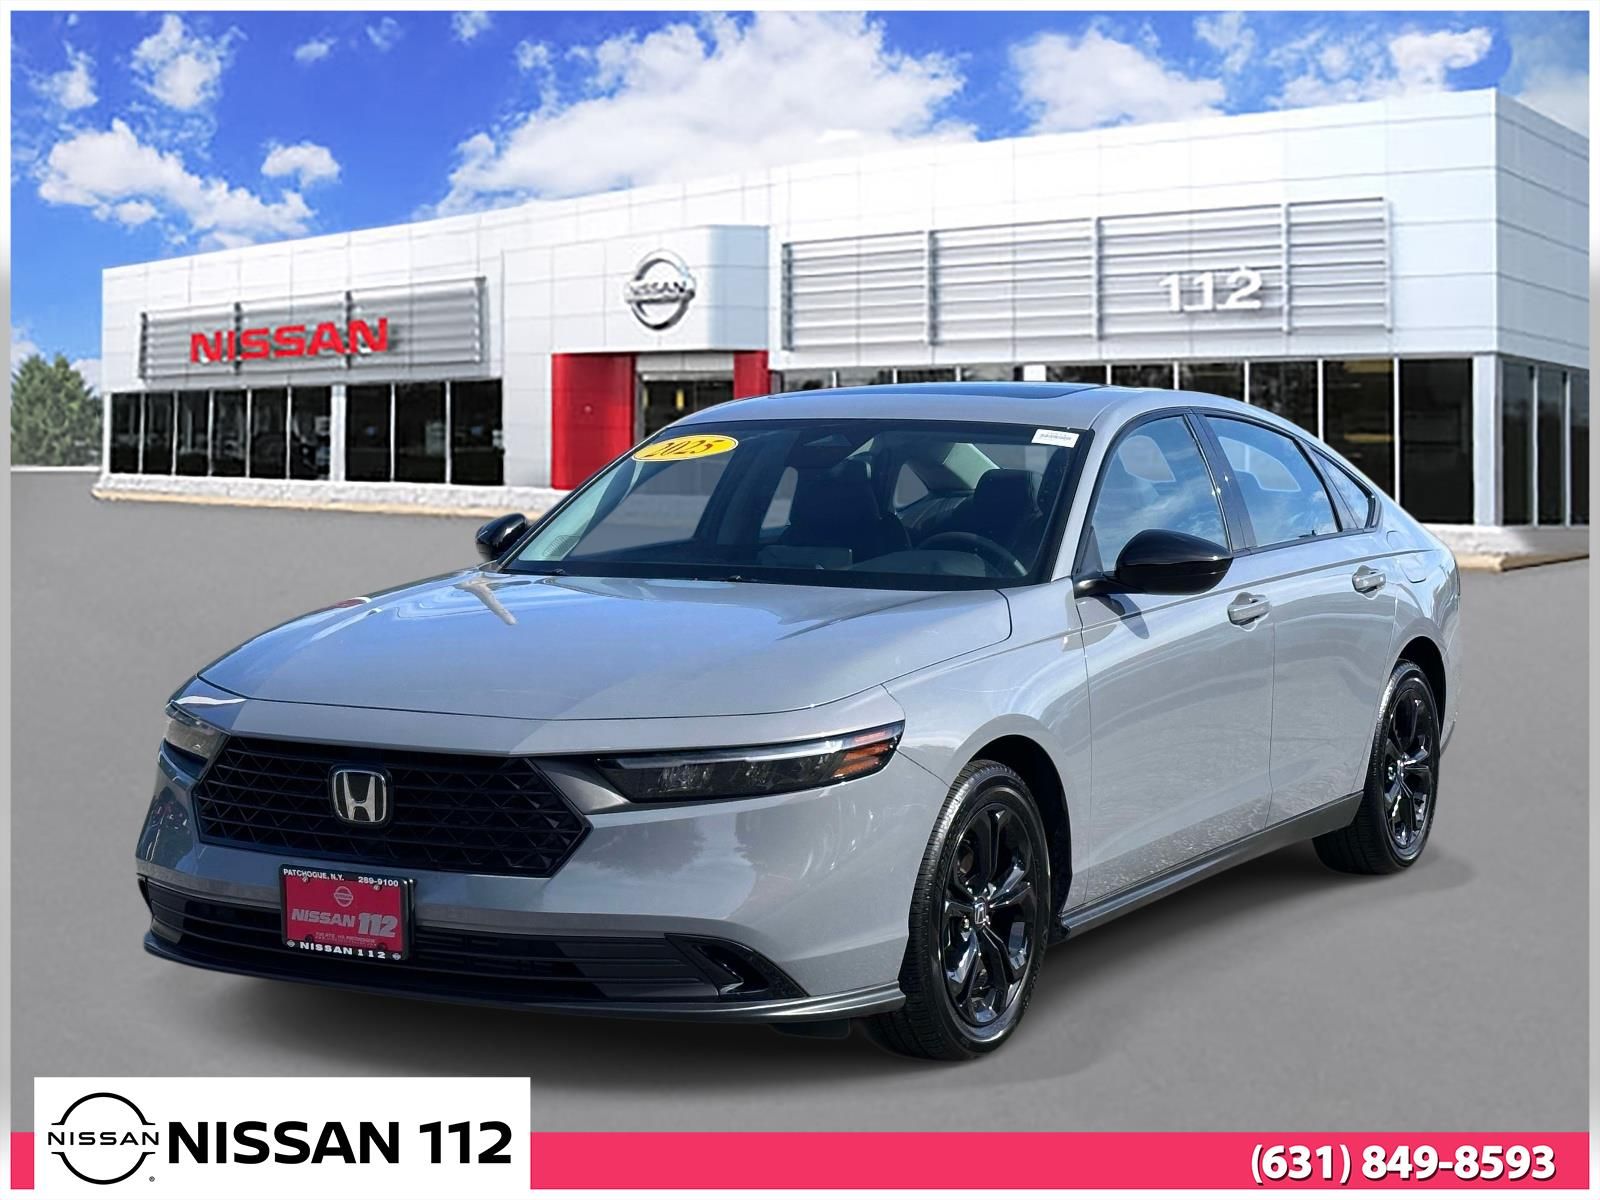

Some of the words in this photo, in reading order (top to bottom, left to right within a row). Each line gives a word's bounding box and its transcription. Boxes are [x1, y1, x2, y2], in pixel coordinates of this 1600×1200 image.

[1158, 268, 1263, 312] 112
[189, 317, 389, 363] NISSAN
[643, 439, 726, 458] 2025
[357, 876, 399, 887] 289-9100
[291, 908, 356, 928] NISSAN
[358, 912, 398, 938] 112
[299, 941, 353, 955] NISSAN
